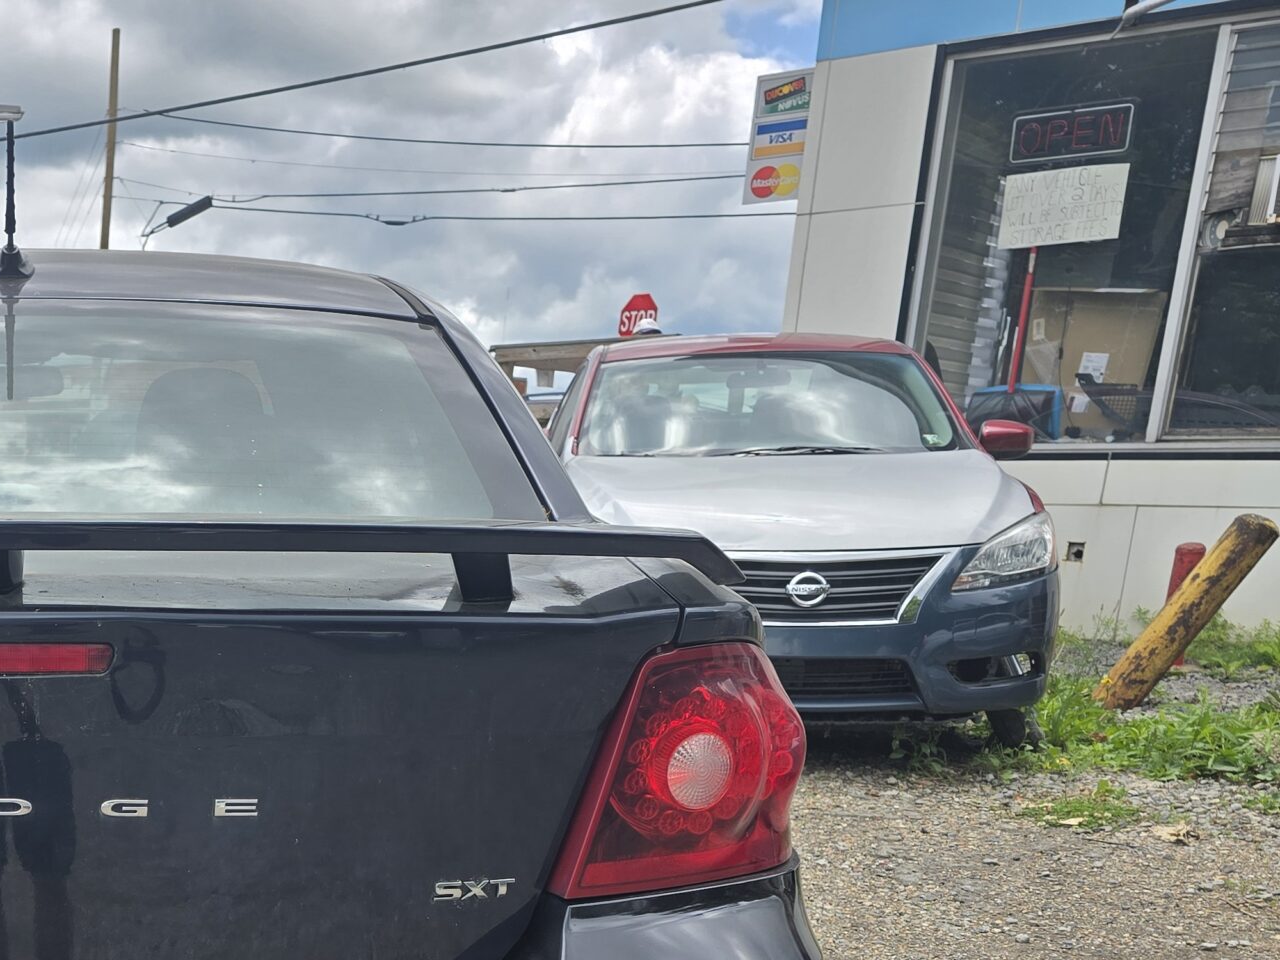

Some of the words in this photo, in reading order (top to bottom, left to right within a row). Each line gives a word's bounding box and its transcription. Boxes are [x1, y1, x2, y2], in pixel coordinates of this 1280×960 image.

[768, 133, 793, 144] VISA
[1020, 113, 1124, 156] OPEN
[1007, 175, 1037, 193] ANY
[1043, 168, 1102, 191] VEHICLE
[1071, 187, 1085, 202] 2
[433, 878, 516, 901] SXT
